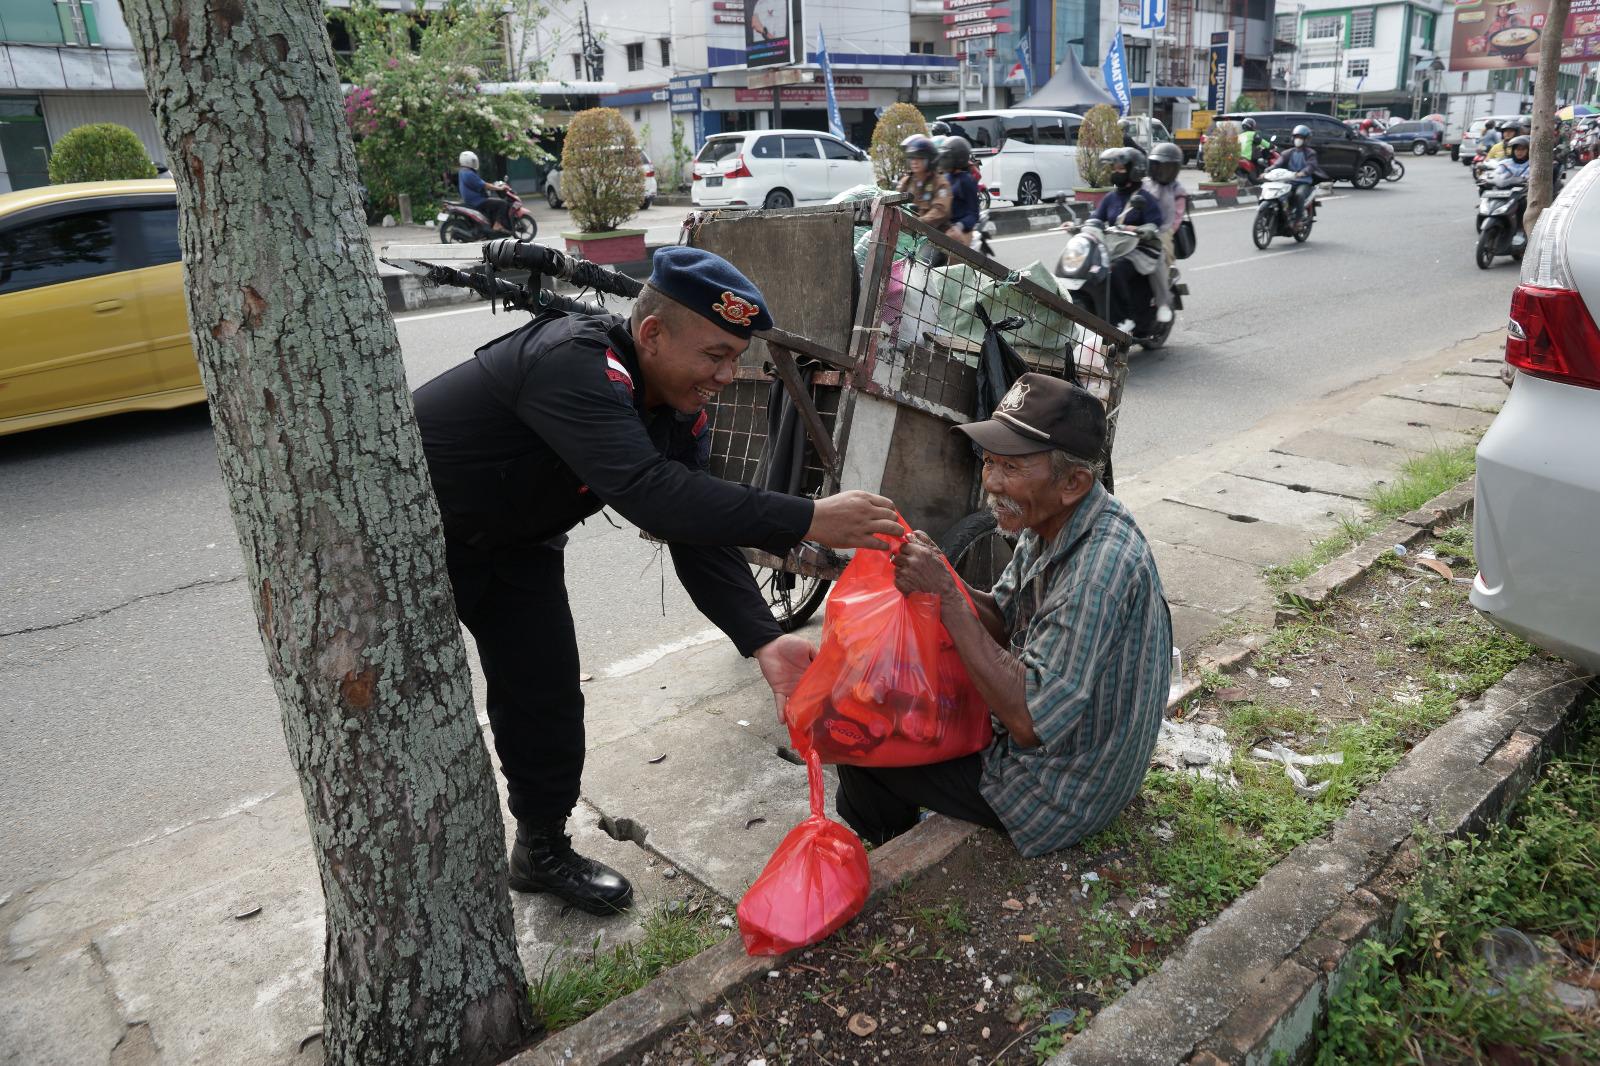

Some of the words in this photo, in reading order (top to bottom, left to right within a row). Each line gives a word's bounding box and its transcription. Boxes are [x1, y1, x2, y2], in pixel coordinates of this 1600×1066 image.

[954, 11, 988, 22] BENGKEL
[945, 29, 966, 39] SUKU
[967, 24, 998, 36] CADANG
[1216, 63, 1226, 112] mandiri
